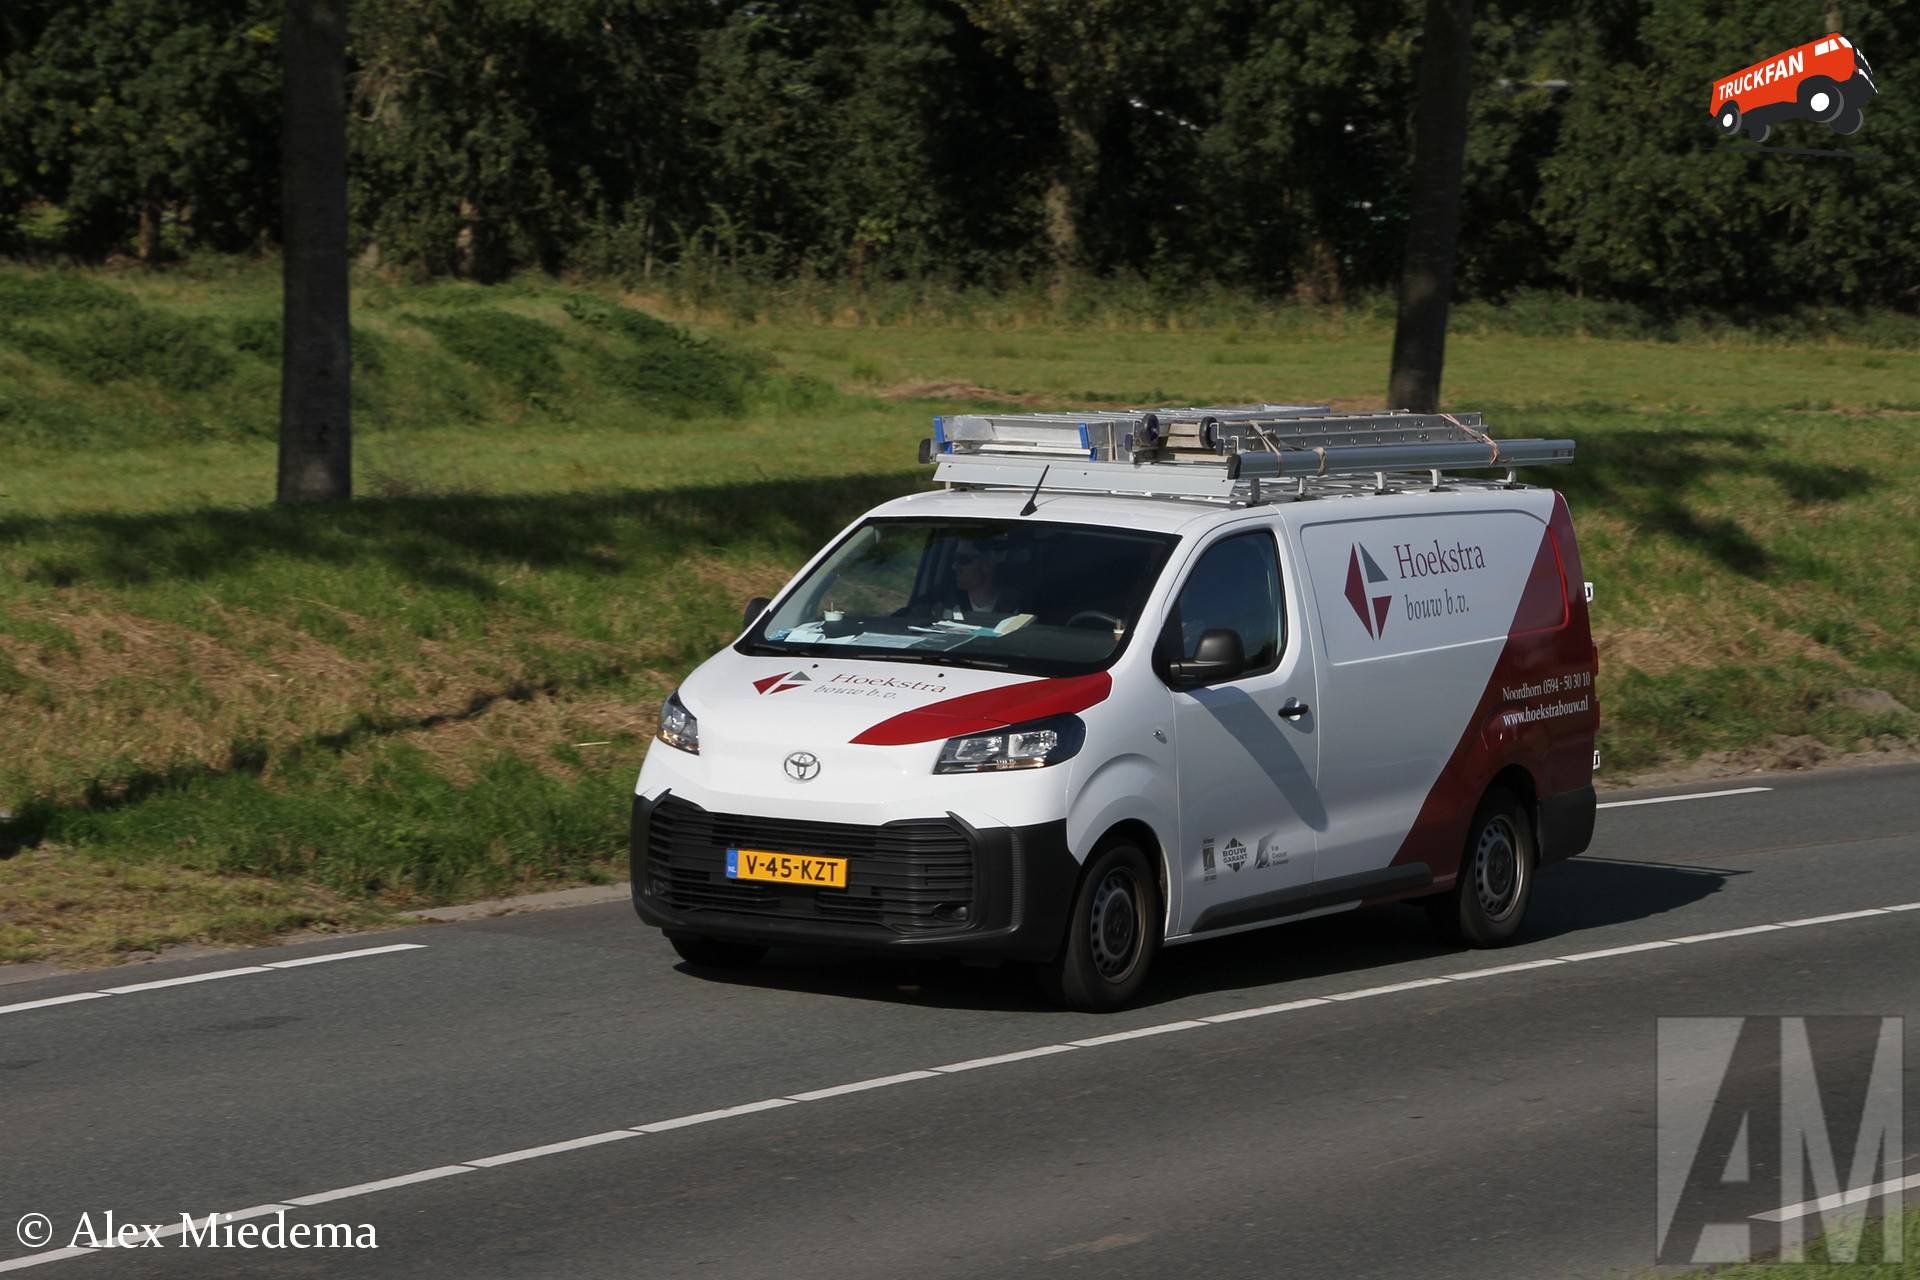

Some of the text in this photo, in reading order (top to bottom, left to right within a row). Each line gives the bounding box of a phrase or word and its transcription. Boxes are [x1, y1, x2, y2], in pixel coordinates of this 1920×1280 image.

[1393, 539, 1486, 579] Hoekstra
[1404, 588, 1470, 620] bouw b.v.
[813, 685, 897, 699] bouw b.v.
[830, 673, 947, 694] Hoekstra
[1502, 682, 1542, 701] Noordhorn
[1543, 678, 1559, 694] 0594
[1564, 674, 1572, 690] 50
[1582, 671, 1591, 687] 10
[1502, 695, 1589, 727] www.hoekstrabouw.nl
[1222, 847, 1247, 857] BOUW
[746, 855, 838, 882] V-45-KZT
